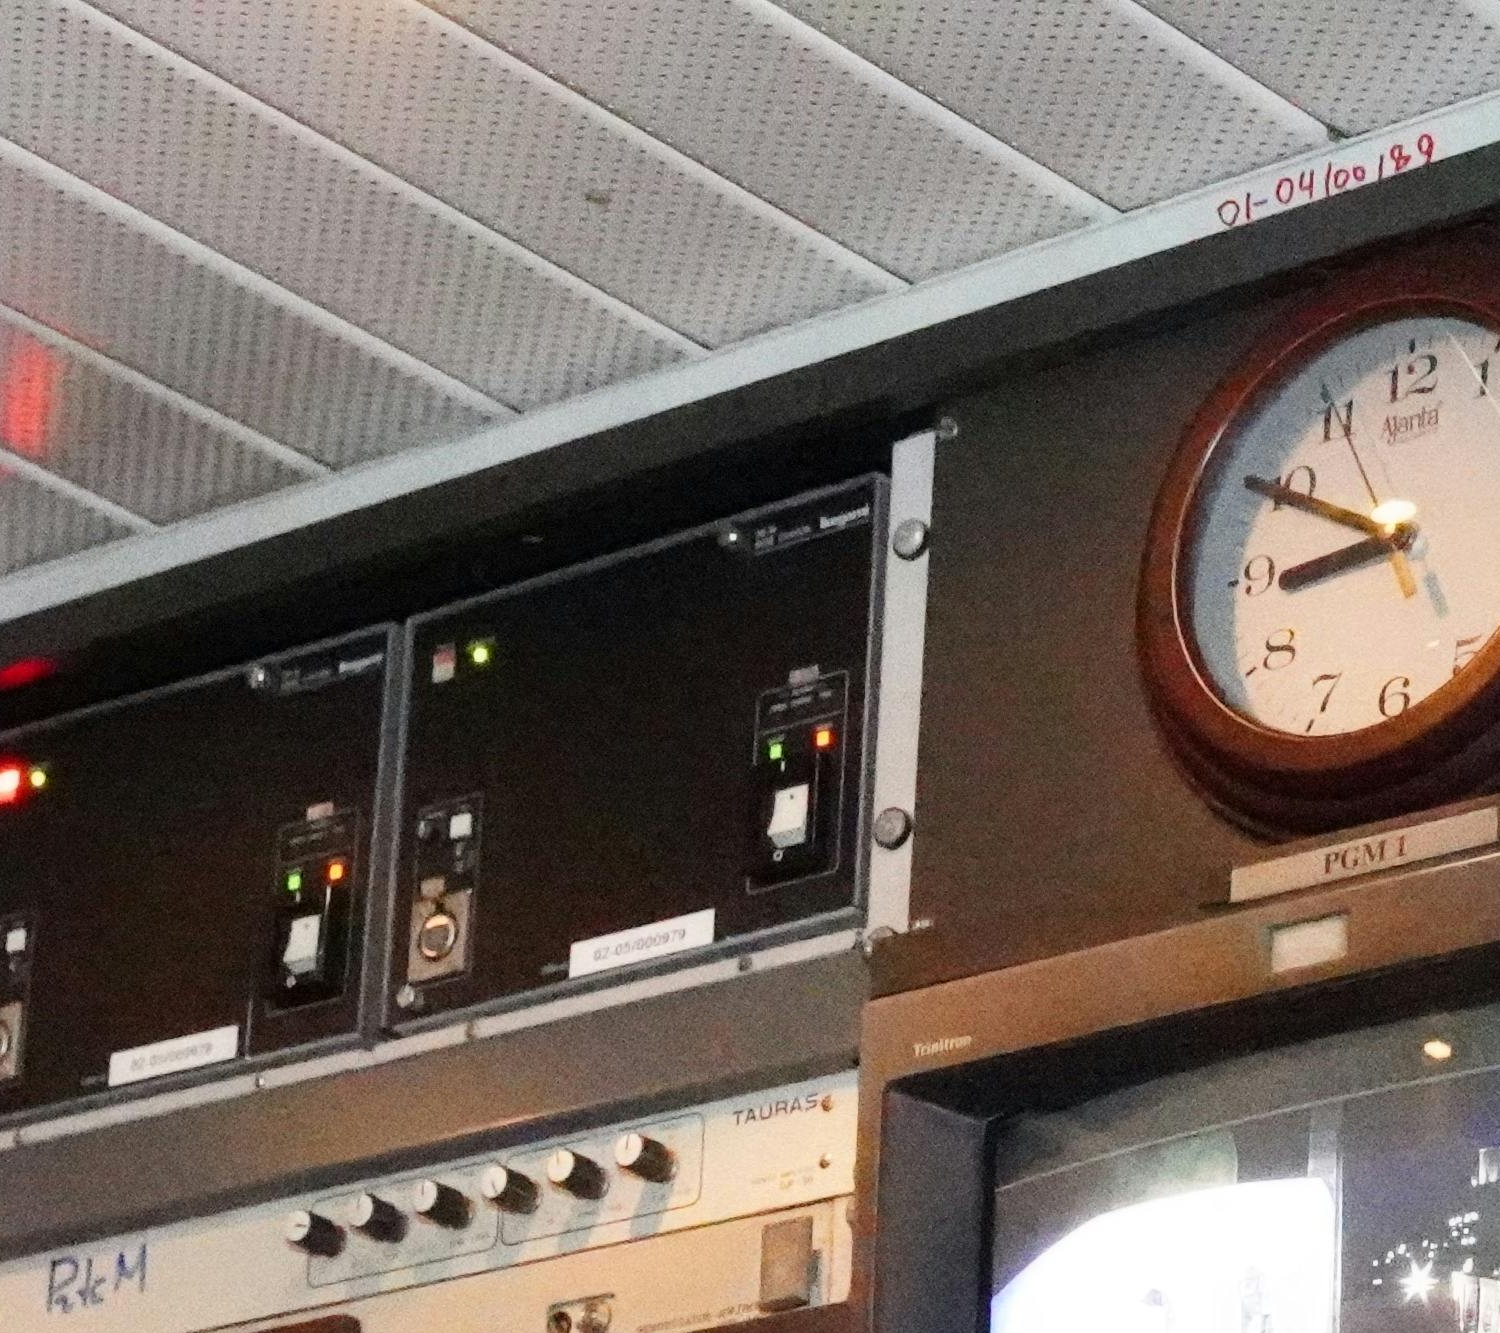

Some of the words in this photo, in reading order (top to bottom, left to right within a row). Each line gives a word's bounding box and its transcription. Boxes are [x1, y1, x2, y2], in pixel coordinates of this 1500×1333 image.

[1386, 353, 1438, 403] 12
[1475, 359, 1490, 400] 1
[1381, 405, 1440, 444] Ajanta
[1244, 554, 1276, 597] 9
[1263, 628, 1296, 671] 8
[1312, 671, 1342, 714] 7
[1378, 675, 1411, 718] 6
[1323, 839, 1390, 877] PGM
[1395, 835, 1408, 859] 1
[912, 1035, 972, 1059] Trinitron
[732, 1092, 819, 1126] TAURAS
